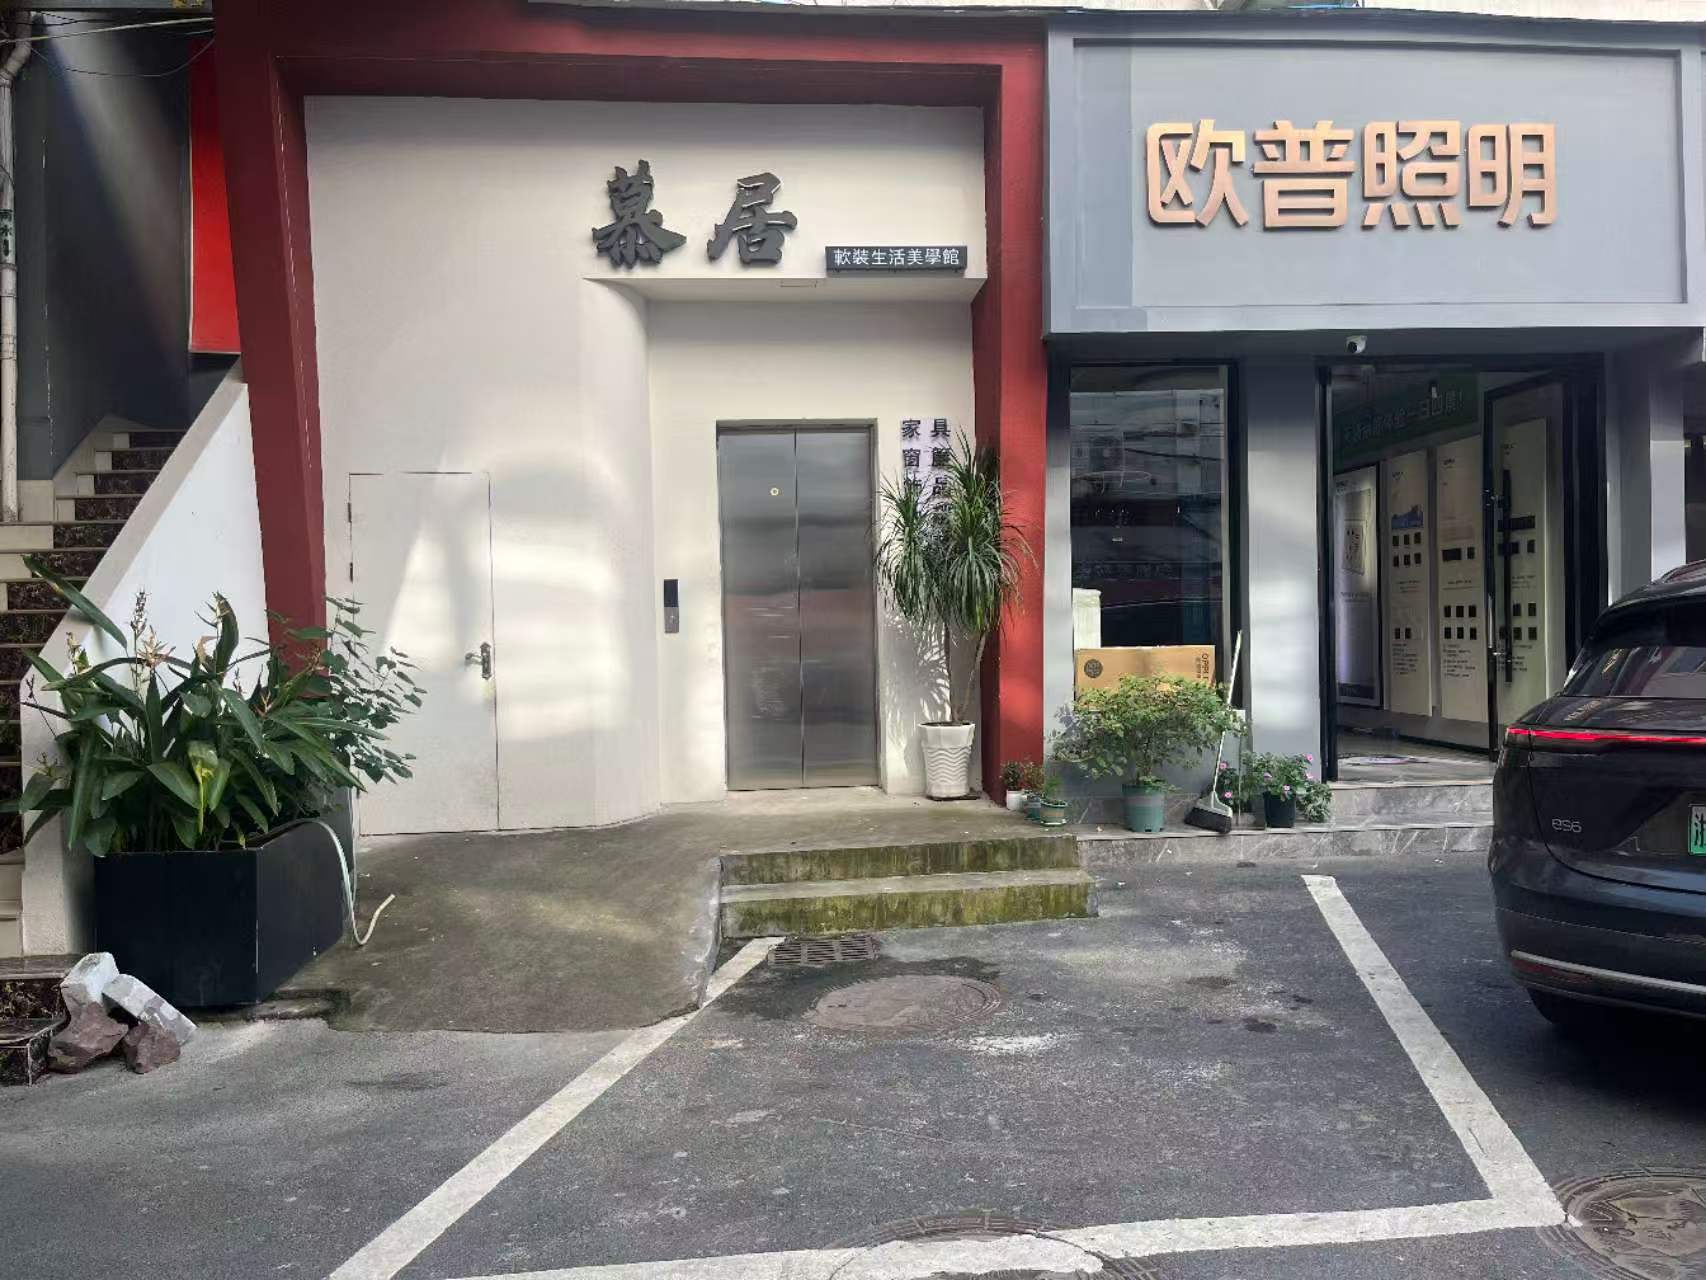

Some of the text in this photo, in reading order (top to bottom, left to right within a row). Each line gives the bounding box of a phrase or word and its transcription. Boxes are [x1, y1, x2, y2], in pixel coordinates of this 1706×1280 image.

[1147, 119, 1558, 228] 欧普照明
[833, 248, 960, 266] 軟裝生活美學館
[902, 418, 951, 438] 家具
